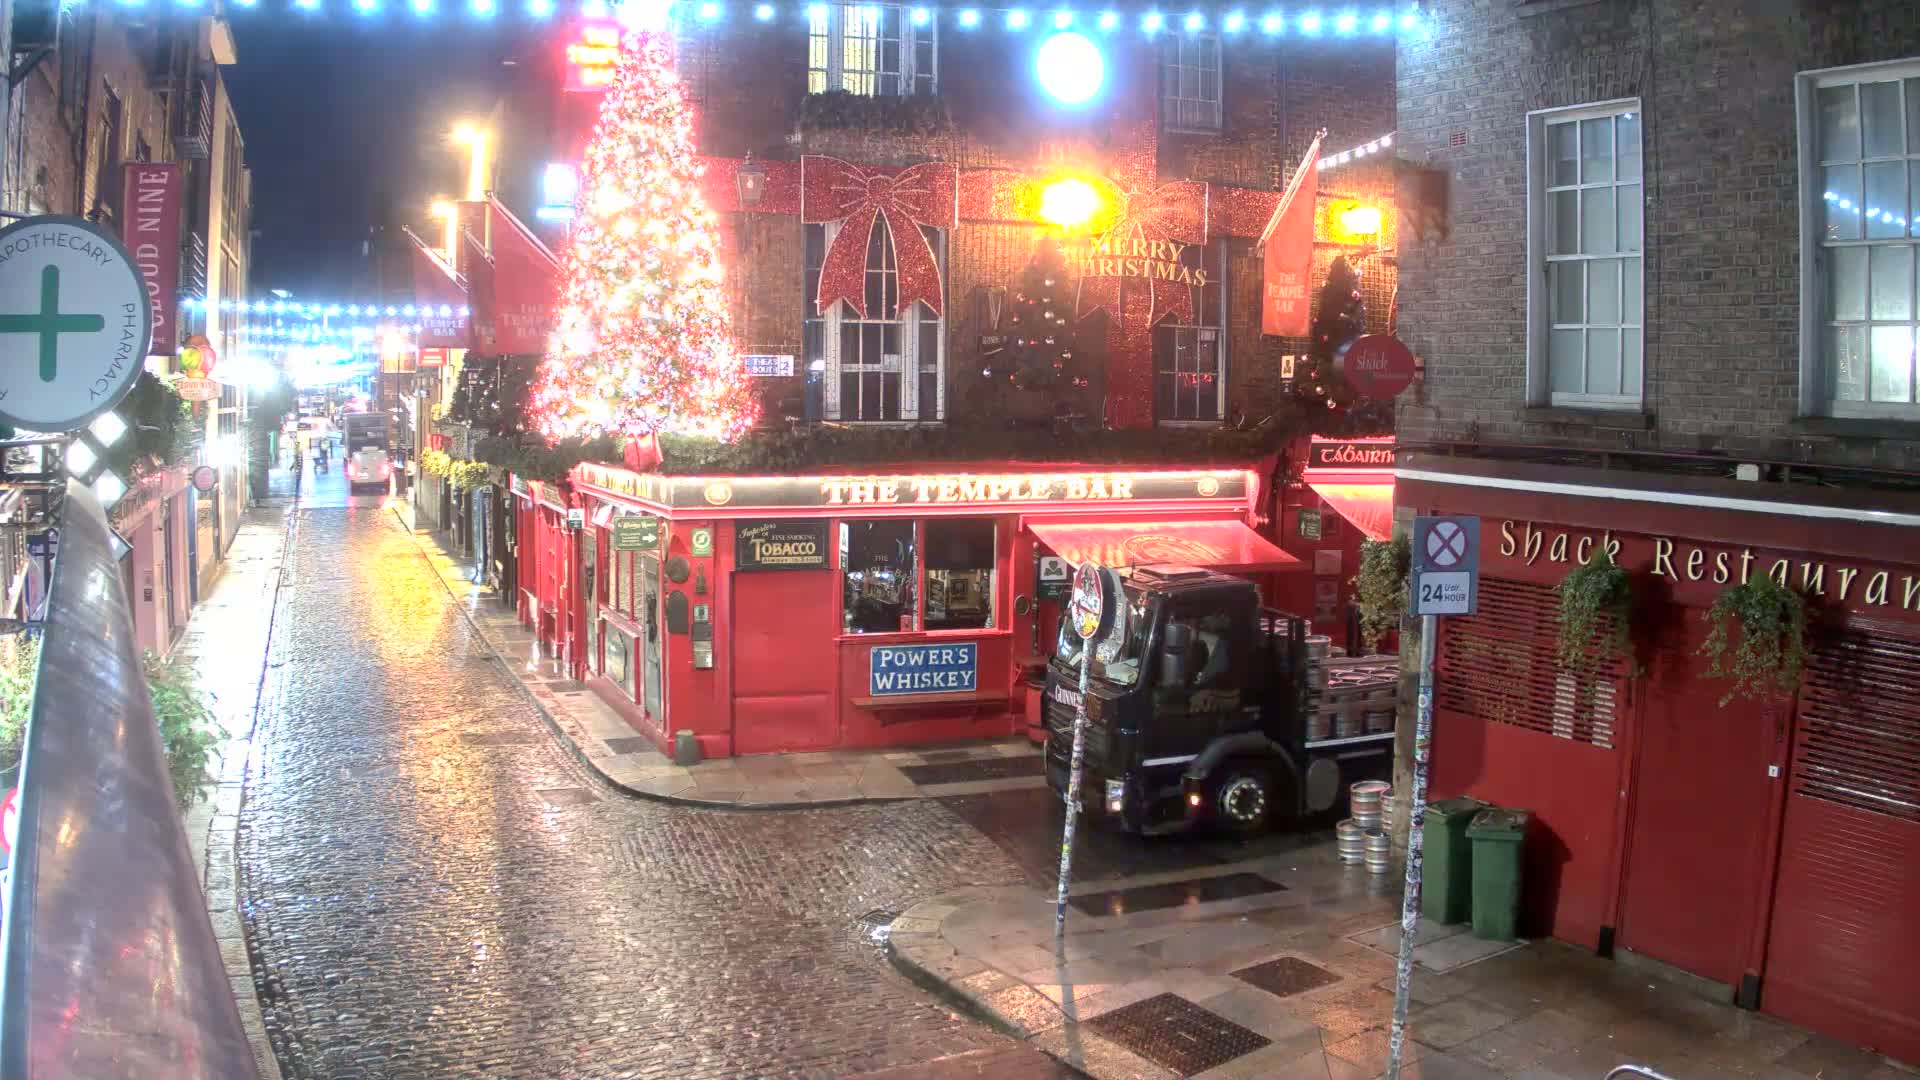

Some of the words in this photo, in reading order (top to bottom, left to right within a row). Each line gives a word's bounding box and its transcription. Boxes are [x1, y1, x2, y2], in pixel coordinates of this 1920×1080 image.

[137, 171, 168, 232] NINE
[1089, 237, 1185, 261] MERRY
[1079, 257, 1207, 287] HRISTMAS
[87, 303, 136, 401] PHARMACY
[752, 366, 778, 374] SOUTH
[822, 480, 898, 504] THE
[911, 477, 1054, 502] TEMPLE
[1066, 476, 1134, 499] BAR
[750, 539, 816, 561] TOBACCO
[1500, 520, 1620, 567] Shack
[1422, 584, 1443, 602] 24
[1444, 593, 1466, 602] HOUR
[879, 648, 969, 668] POWER'S
[874, 670, 974, 690] WHISKEY
